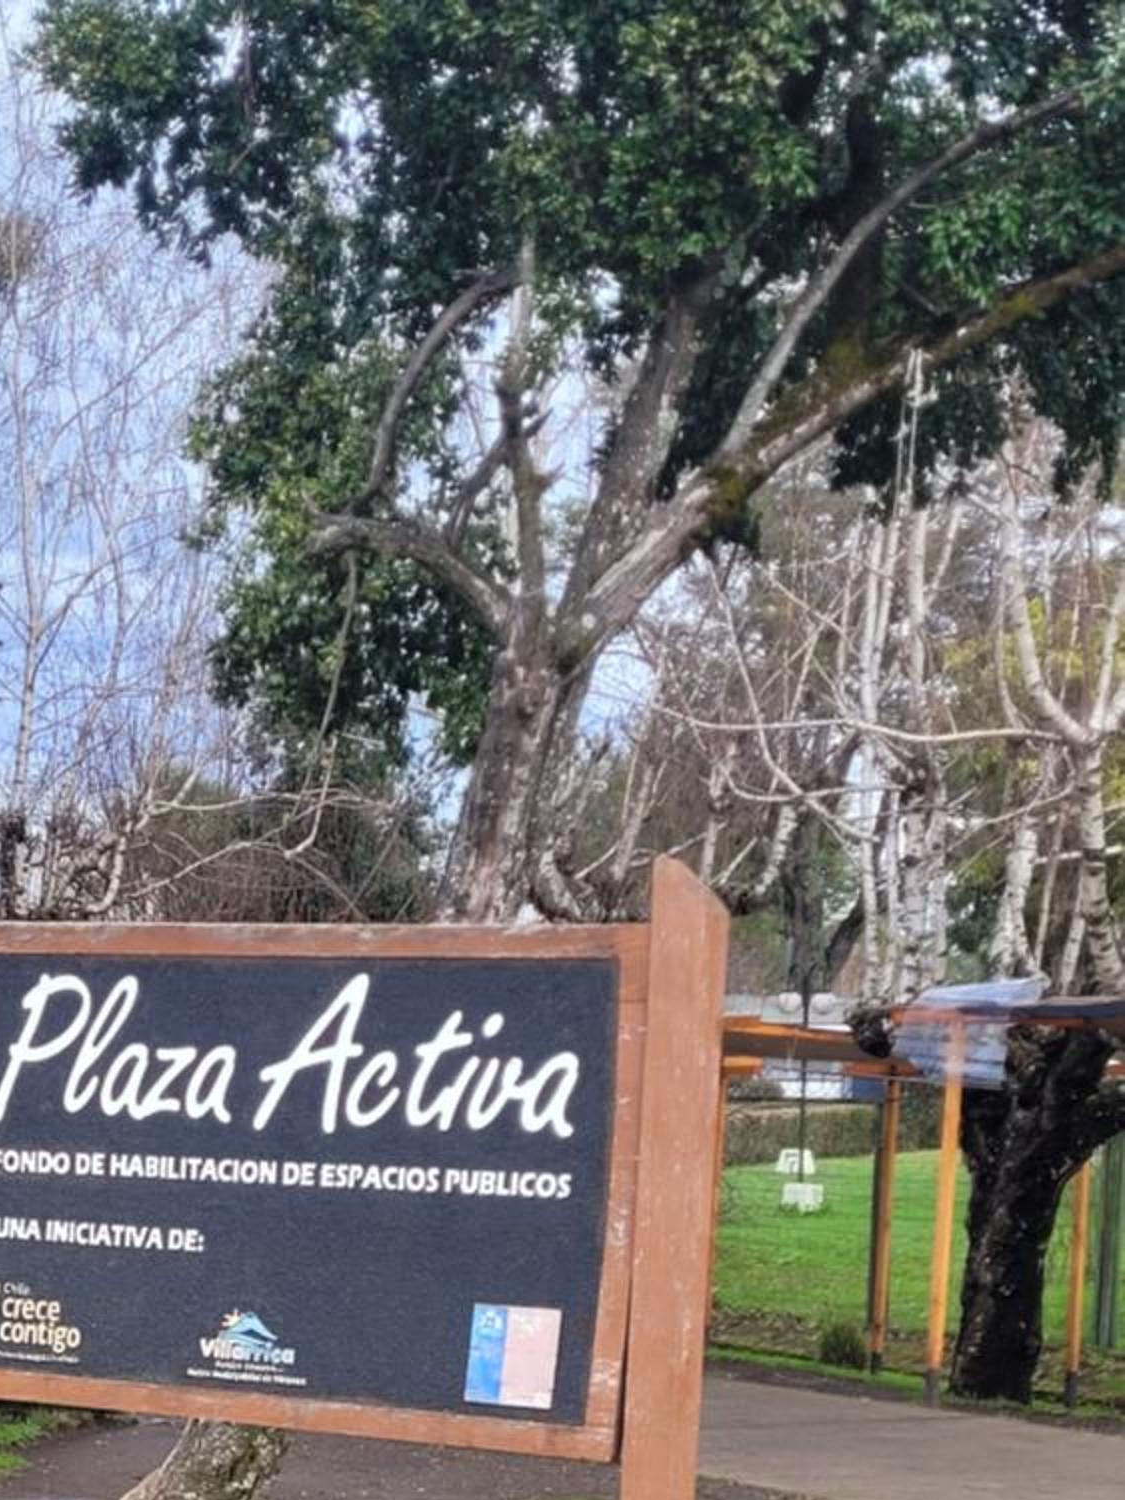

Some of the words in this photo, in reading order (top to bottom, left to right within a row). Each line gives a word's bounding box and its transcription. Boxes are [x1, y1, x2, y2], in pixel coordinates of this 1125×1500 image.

[252, 972, 581, 1139] Activa
[75, 1153, 105, 1176] DE
[109, 1154, 277, 1185] HABILITACION
[281, 1162, 317, 1187] DE
[319, 1164, 441, 1194] ESPACIOS
[443, 1169, 573, 1200] PUBLICOS
[44, 1220, 163, 1250] INICIATIVA
[167, 1229, 205, 1253] DE:
[1, 1297, 61, 1322] crece
[199, 1336, 296, 1365] Villarrica
